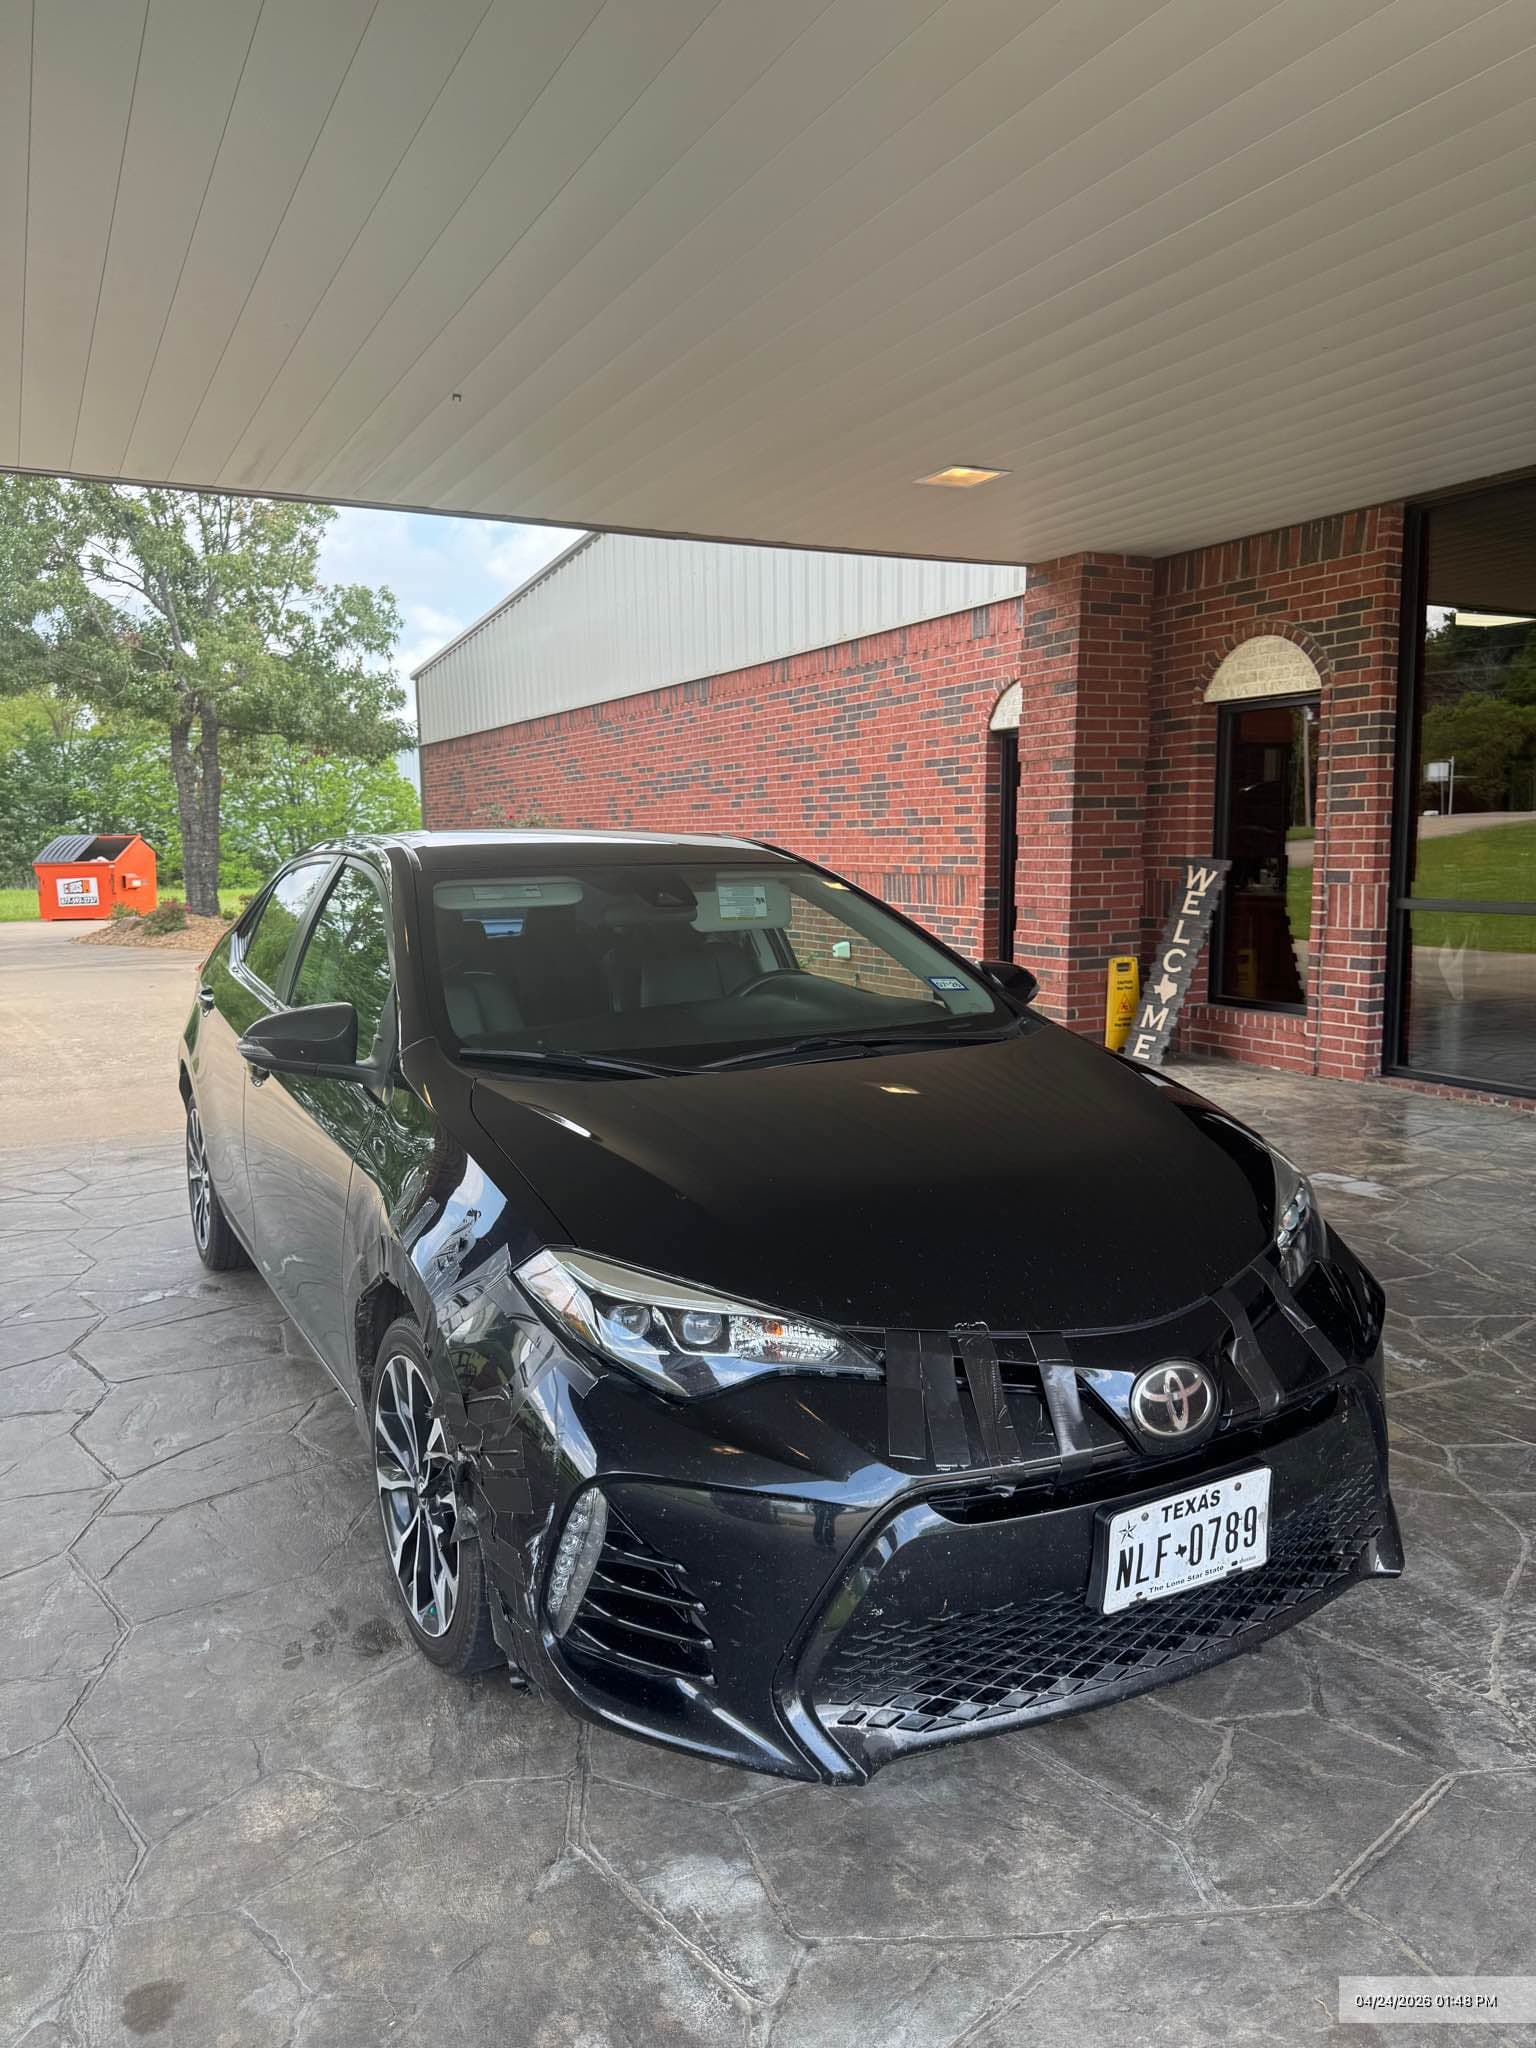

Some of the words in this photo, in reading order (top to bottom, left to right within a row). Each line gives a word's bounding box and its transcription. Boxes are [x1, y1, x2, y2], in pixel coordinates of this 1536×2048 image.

[1132, 864, 1218, 1060] WELCME
[1161, 1489, 1221, 1523] TEXAS
[1148, 1585, 1164, 1593] The
[1166, 1579, 1185, 1588] Lone
[1187, 1572, 1203, 1581] Star
[1204, 1565, 1224, 1576] State
